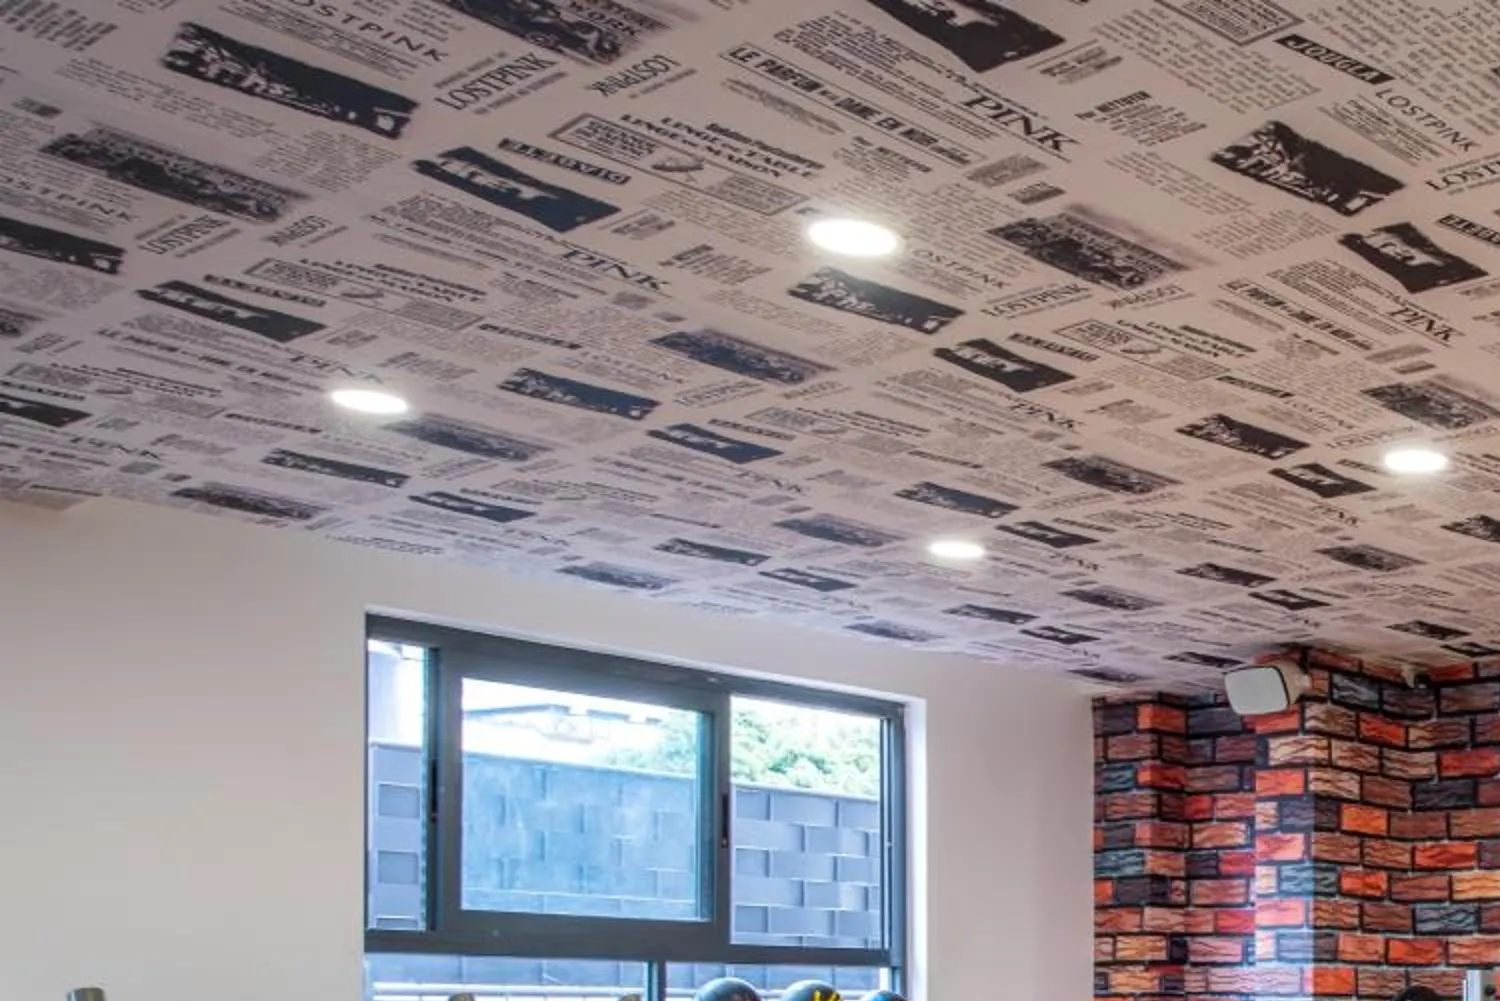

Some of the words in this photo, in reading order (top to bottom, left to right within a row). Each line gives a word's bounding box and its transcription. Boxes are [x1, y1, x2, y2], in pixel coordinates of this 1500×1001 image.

[296, 0, 449, 62] STPINK
[729, 48, 752, 63] LE
[434, 52, 558, 110] LOSTPINK
[963, 95, 1081, 153] PINK
[1375, 88, 1482, 152] LOSTPINK
[562, 248, 671, 292] PINK
[913, 248, 1008, 289] OSTPINK
[1387, 307, 1466, 343] PINK
